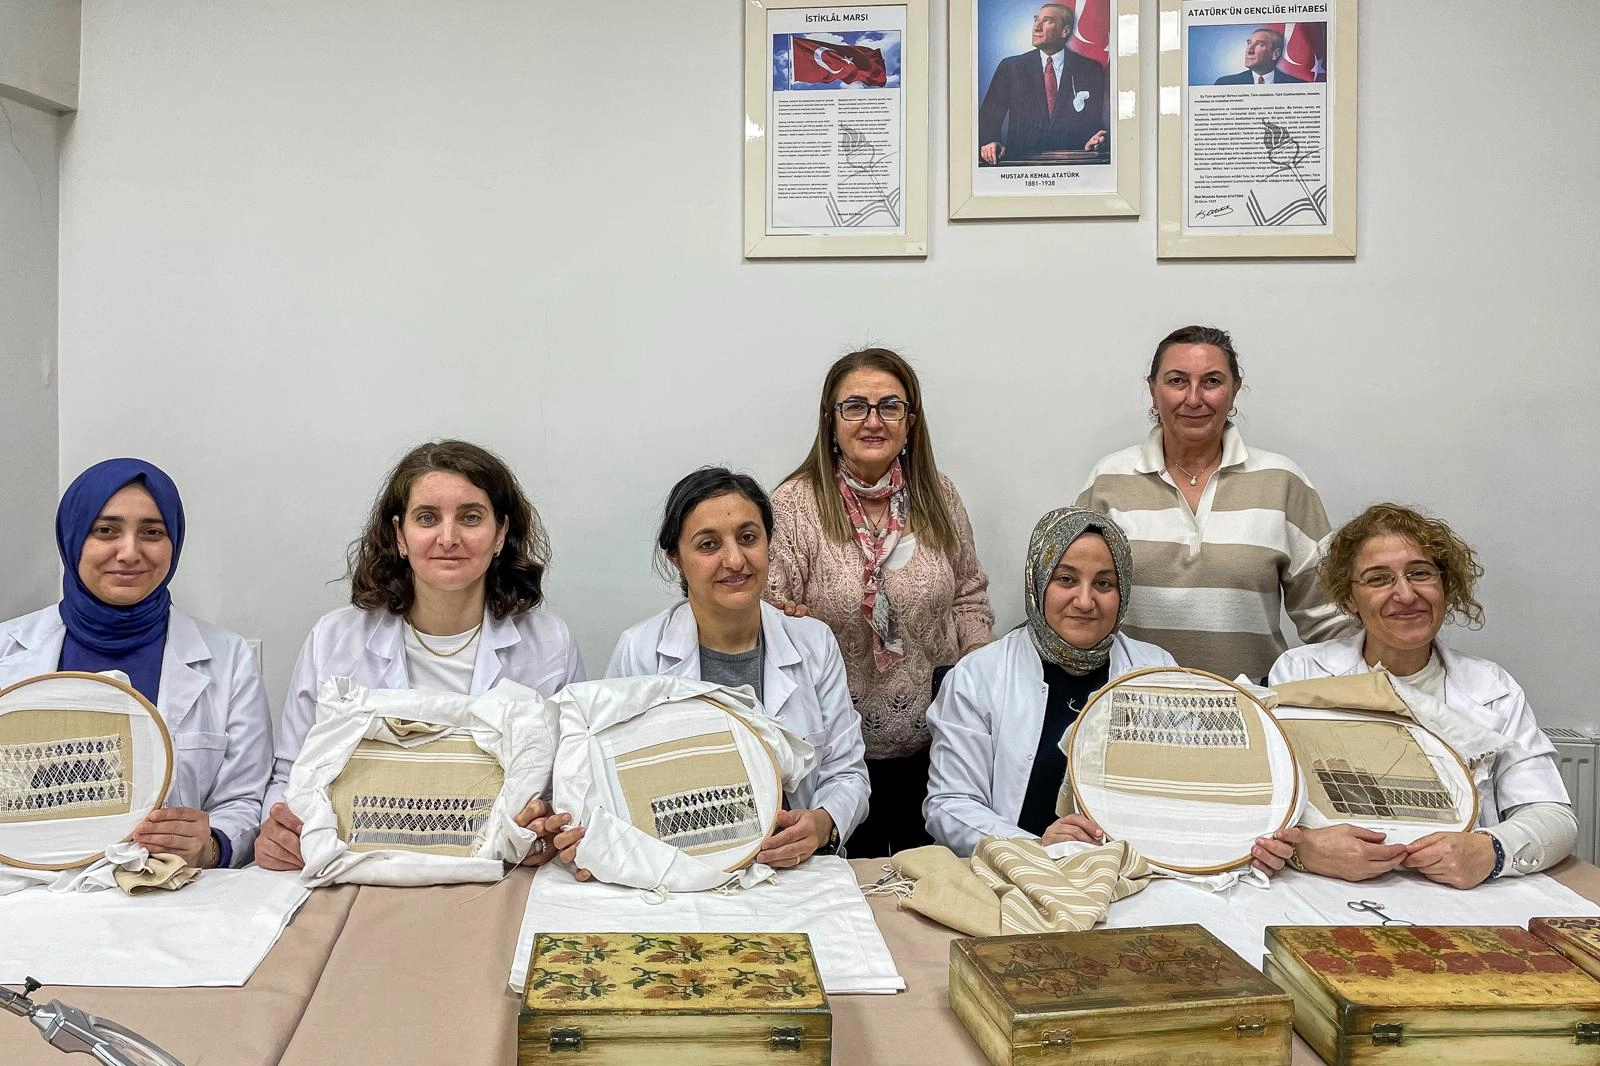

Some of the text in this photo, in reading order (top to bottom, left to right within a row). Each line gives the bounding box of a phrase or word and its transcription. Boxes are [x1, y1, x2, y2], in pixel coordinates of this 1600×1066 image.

[1187, 3, 1328, 17] ATATÜRK'ÜN GENÇLİĞE HİTABESİ
[805, 12, 868, 23] İSTİKLÂL MARŞI
